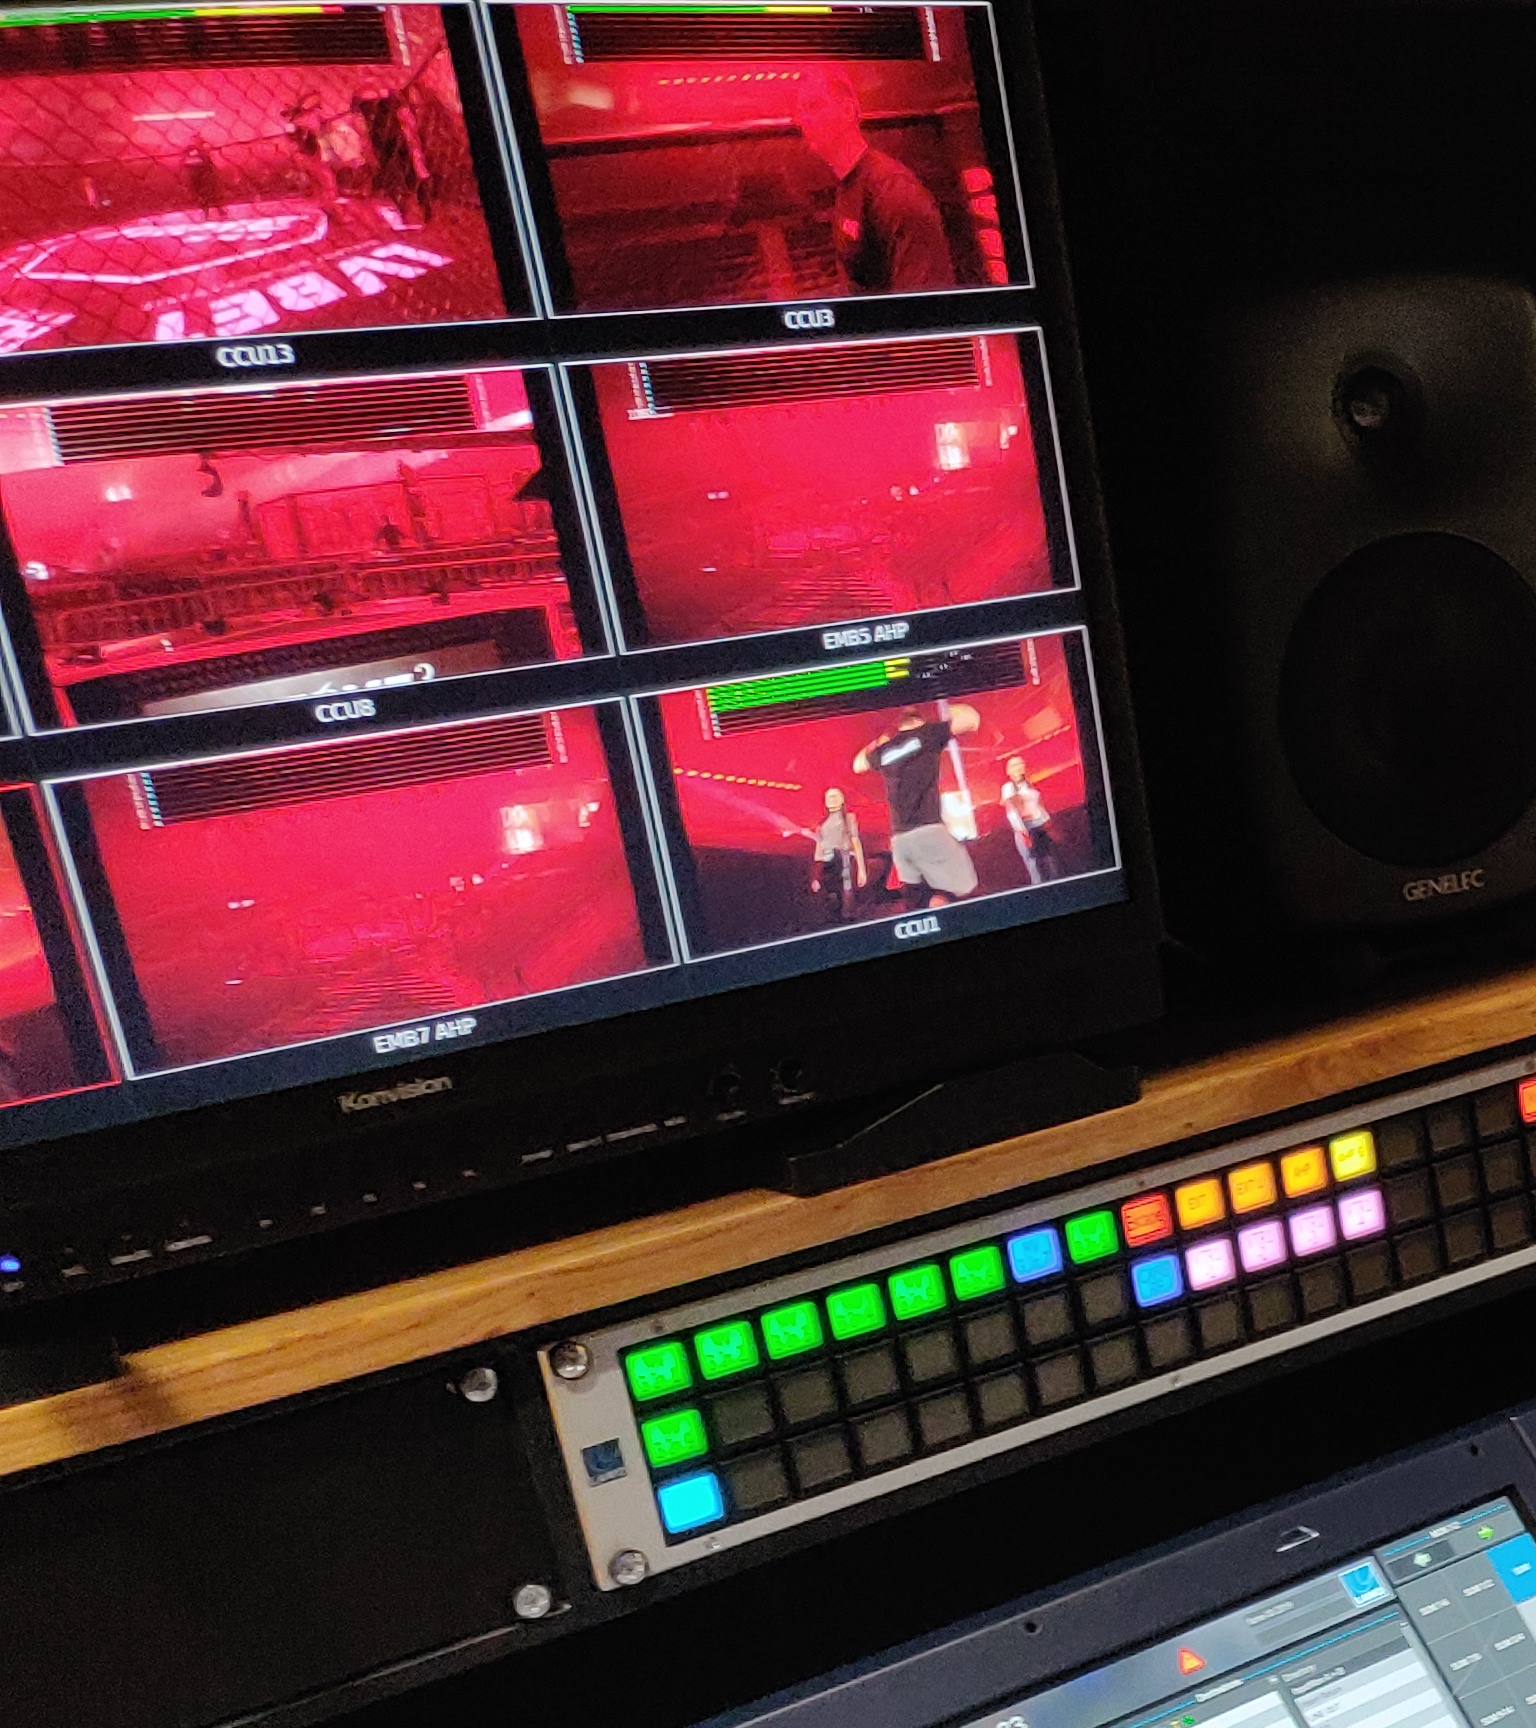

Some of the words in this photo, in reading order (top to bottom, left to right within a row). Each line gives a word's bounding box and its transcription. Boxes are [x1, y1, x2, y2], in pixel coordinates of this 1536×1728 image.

[784, 310, 836, 331] CCU3
[217, 344, 296, 369] CCU13
[315, 699, 376, 723] CCU8
[1405, 871, 1484, 901] GENELEC
[894, 916, 941, 940] CCU1
